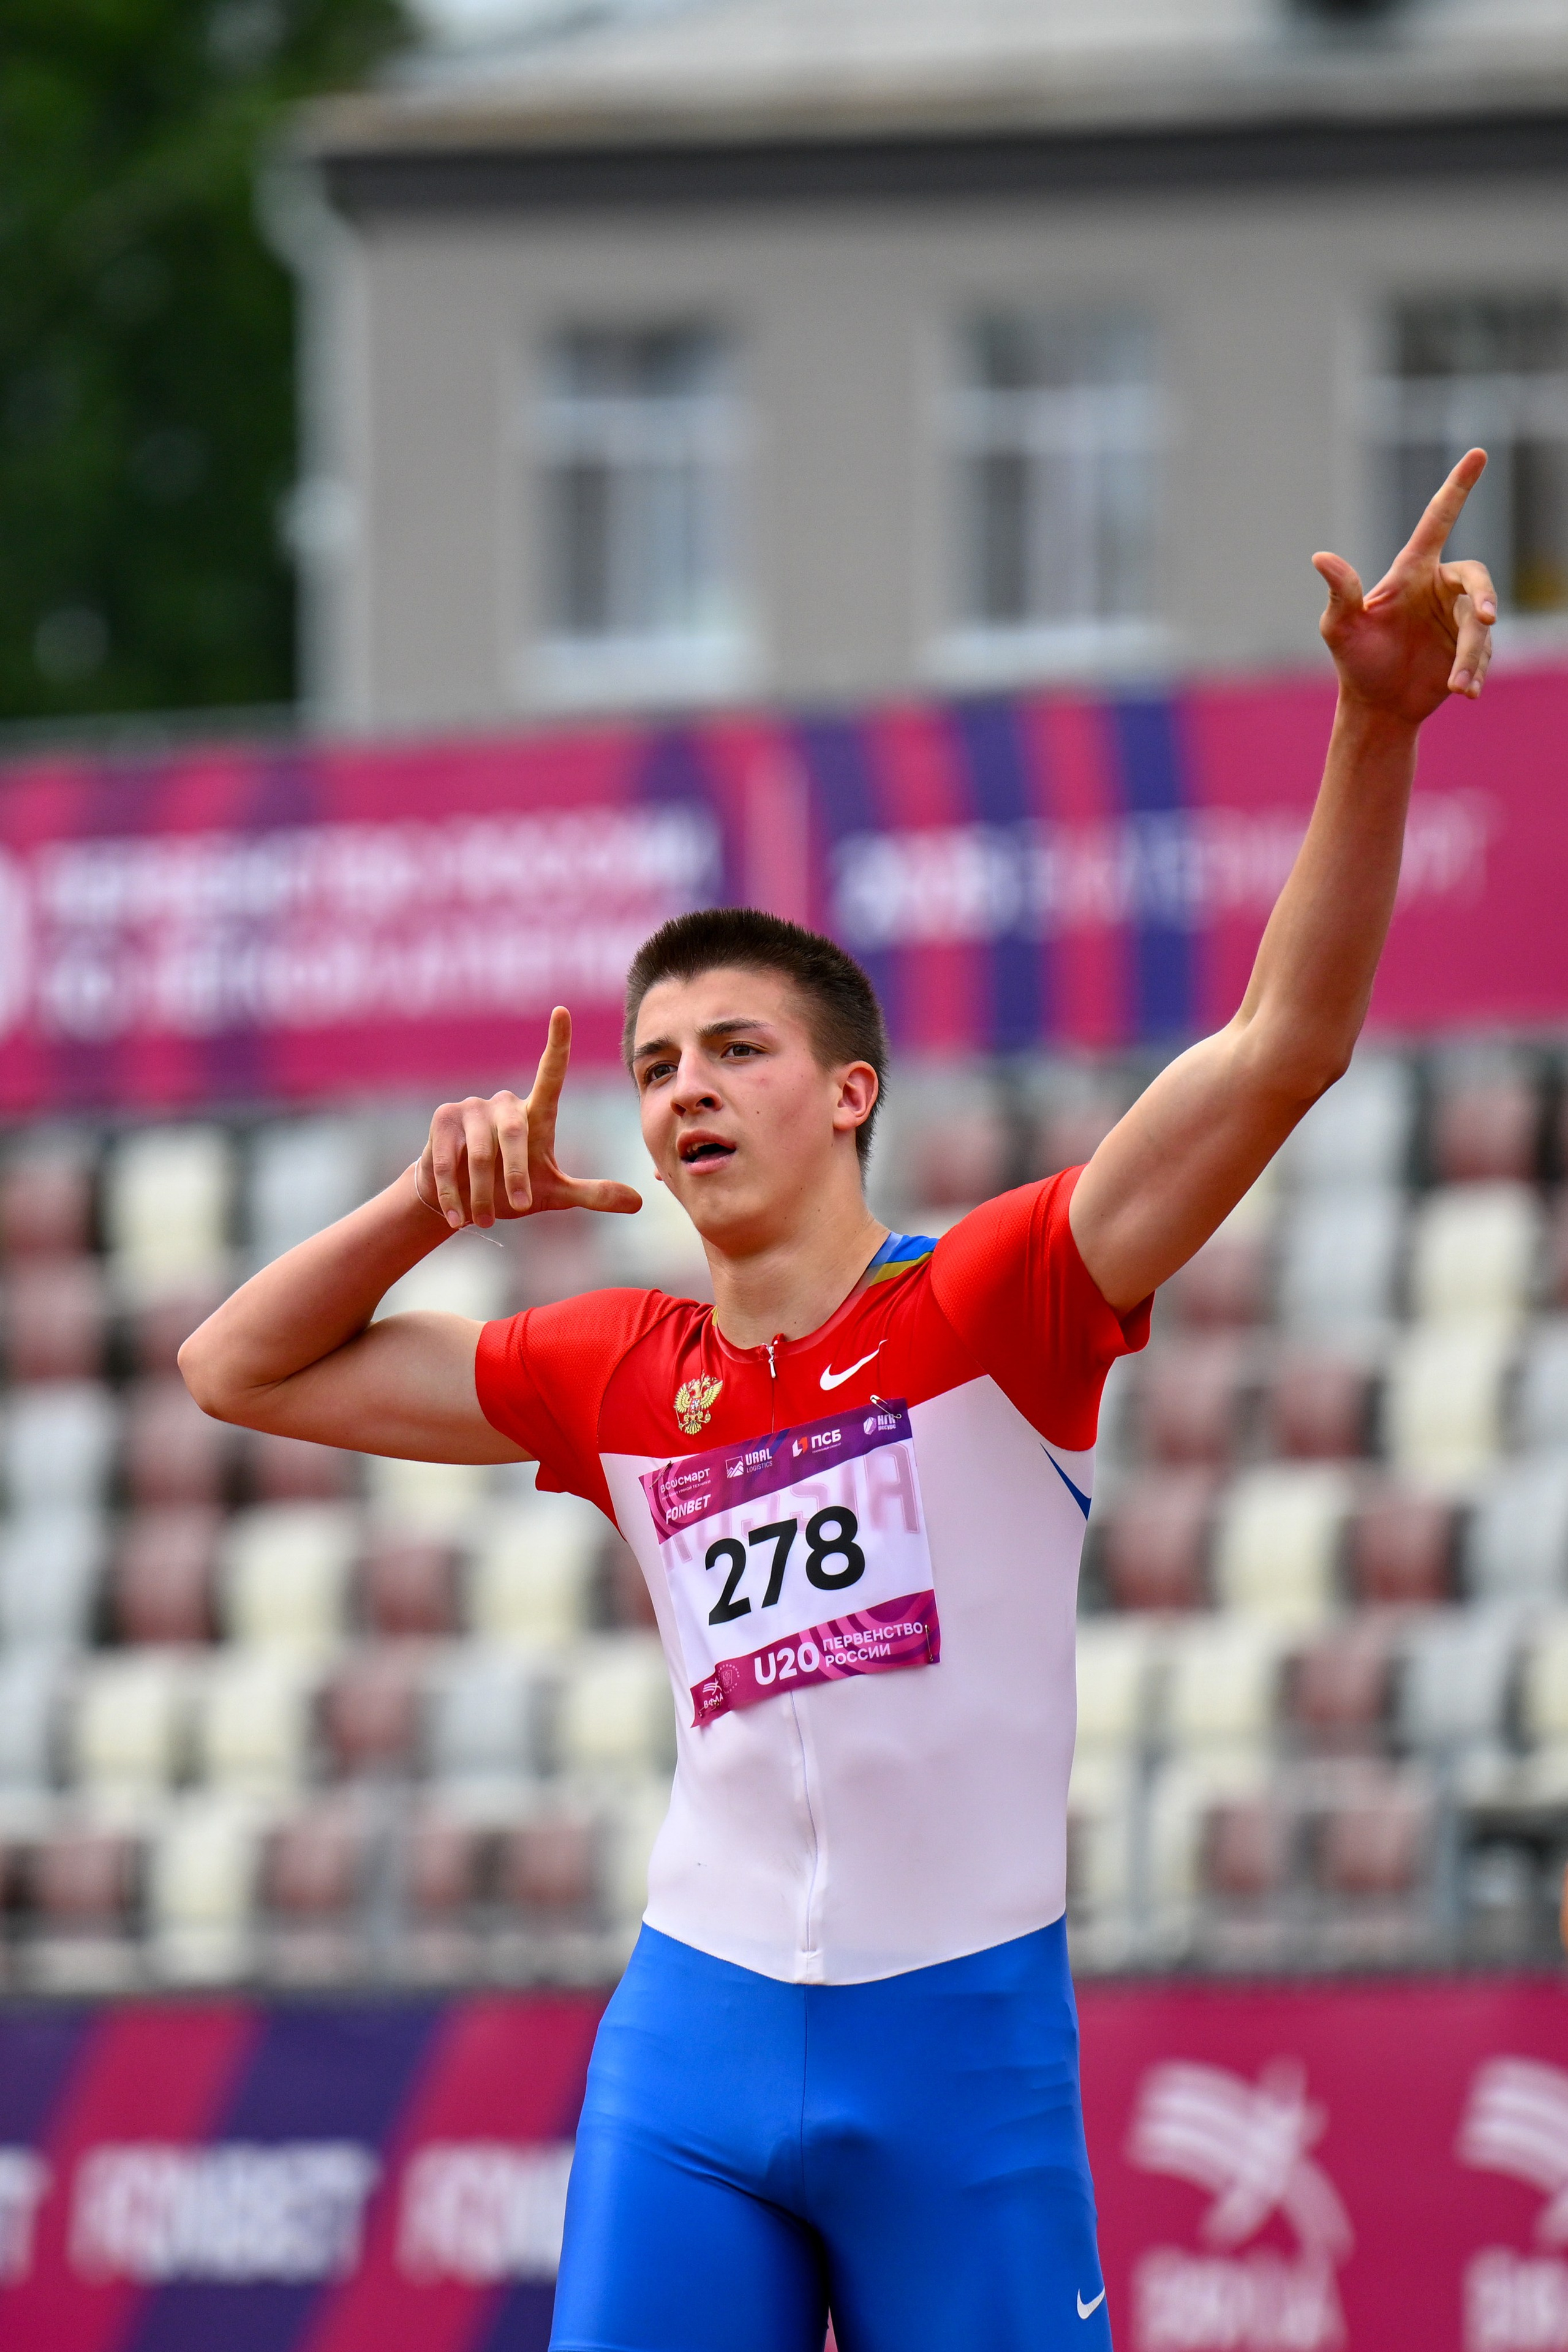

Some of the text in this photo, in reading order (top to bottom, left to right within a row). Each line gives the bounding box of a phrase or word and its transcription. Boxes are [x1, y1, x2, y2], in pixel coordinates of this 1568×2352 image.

[811, 1429, 842, 1449] ПСБ
[745, 1448, 772, 1466] URAL
[747, 1460, 773, 1473] LOGISTICS
[666, 1494, 711, 1525] FONBET
[705, 1506, 865, 1626] 278
[823, 1622, 923, 1651] ПЕРВЕНСТВО
[754, 1642, 820, 1685] U20
[825, 1643, 891, 1667] РОССИИ
